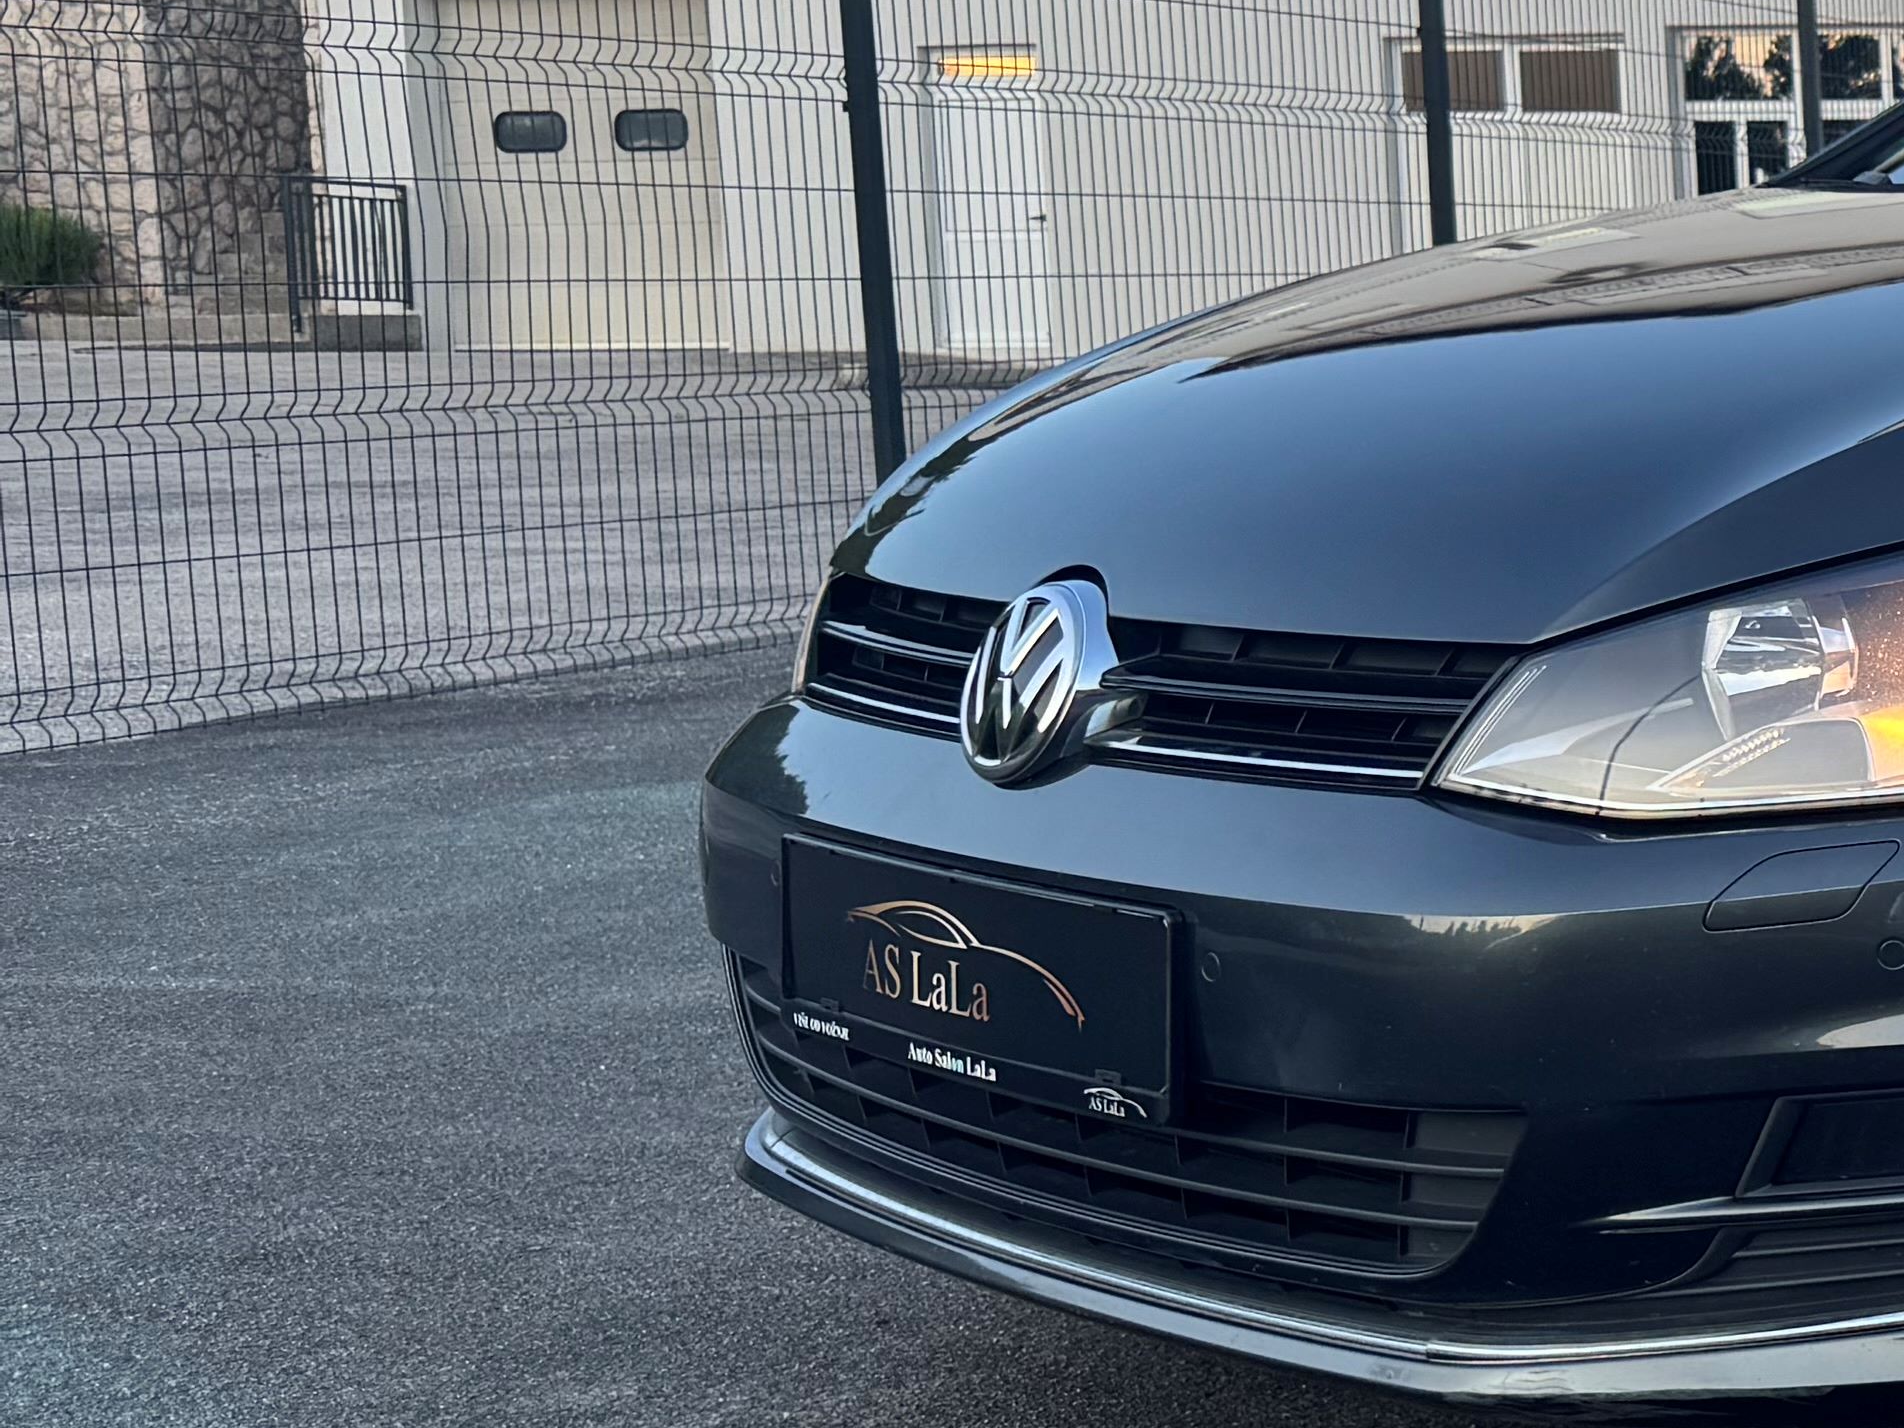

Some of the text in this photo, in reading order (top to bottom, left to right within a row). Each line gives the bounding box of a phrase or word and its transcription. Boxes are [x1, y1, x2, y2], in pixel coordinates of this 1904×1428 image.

[862, 937, 990, 1022] AS LaLa
[907, 1041, 997, 1082] Auto Salon LaLa
